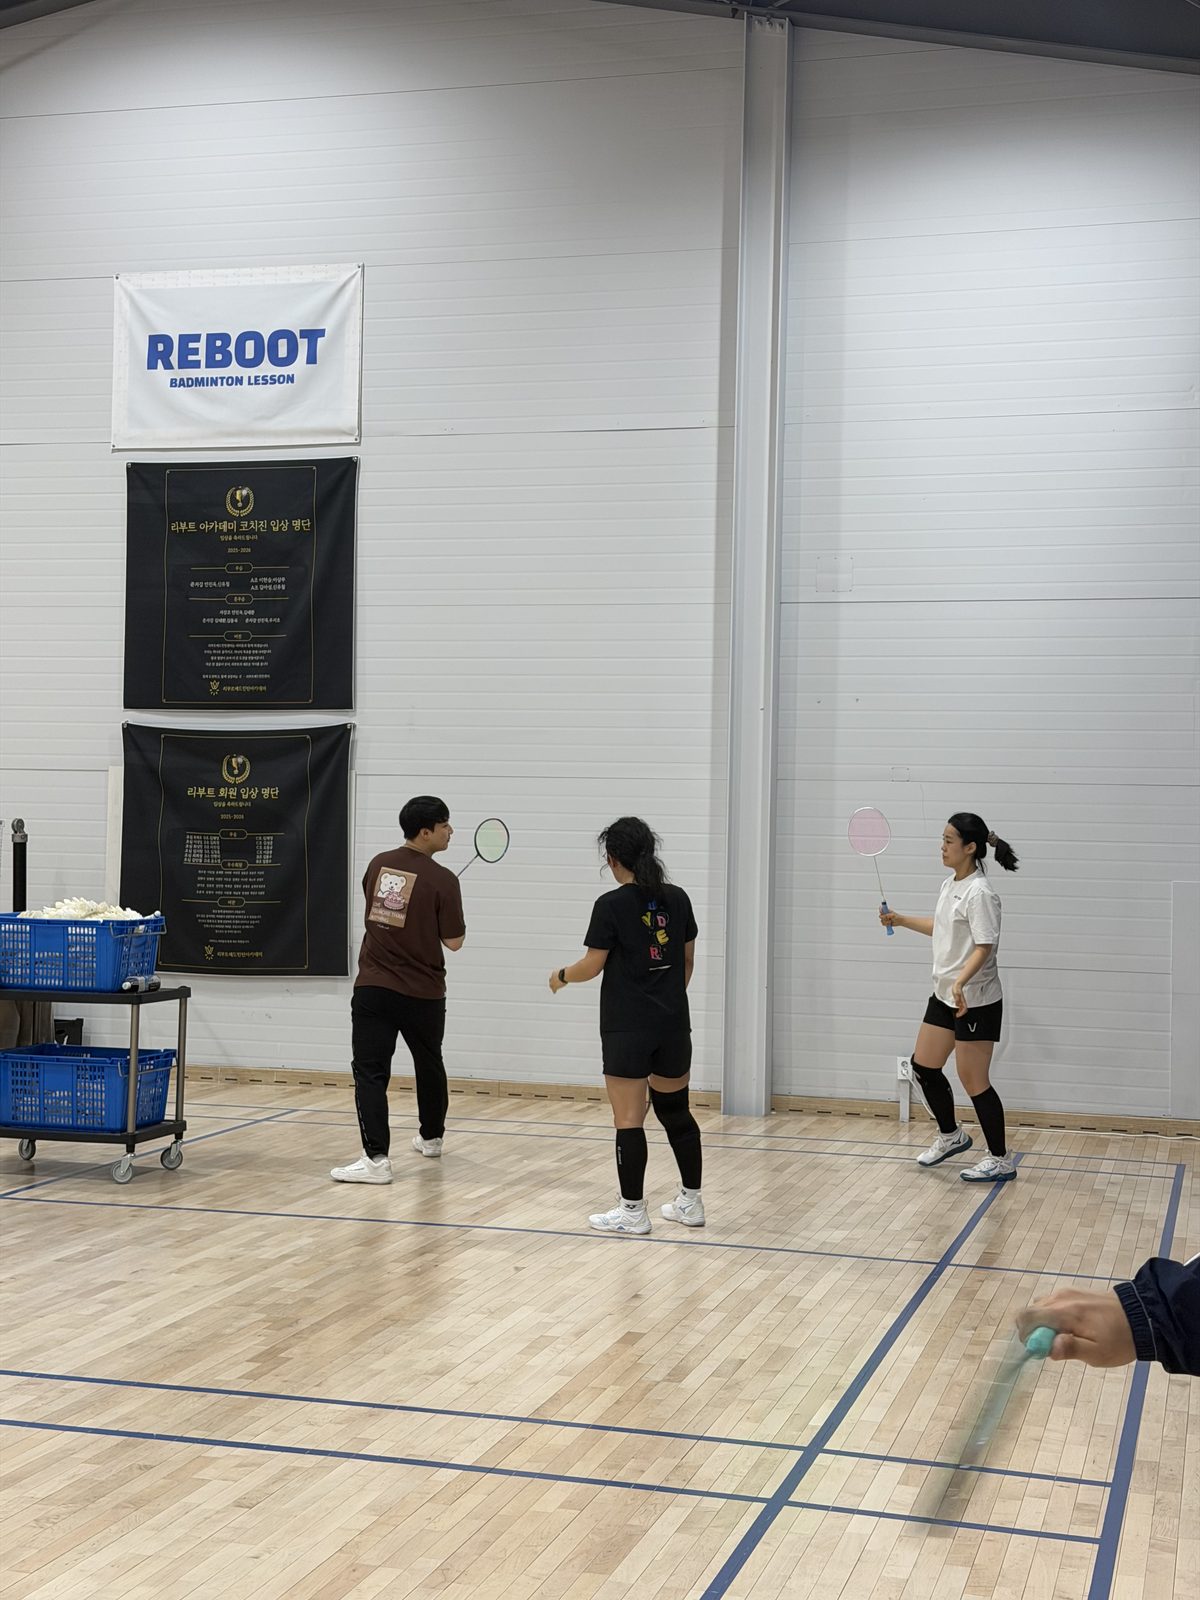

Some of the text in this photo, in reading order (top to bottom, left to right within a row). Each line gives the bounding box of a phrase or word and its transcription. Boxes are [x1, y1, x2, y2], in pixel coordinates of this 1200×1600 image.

[146, 328, 326, 370] REBOOT
[169, 373, 295, 388] BADMINTON LESSON
[171, 518, 311, 533] 리부트 아카데미 코치진 입상 명단
[187, 787, 280, 799] 리부트 회원 입상 명단
